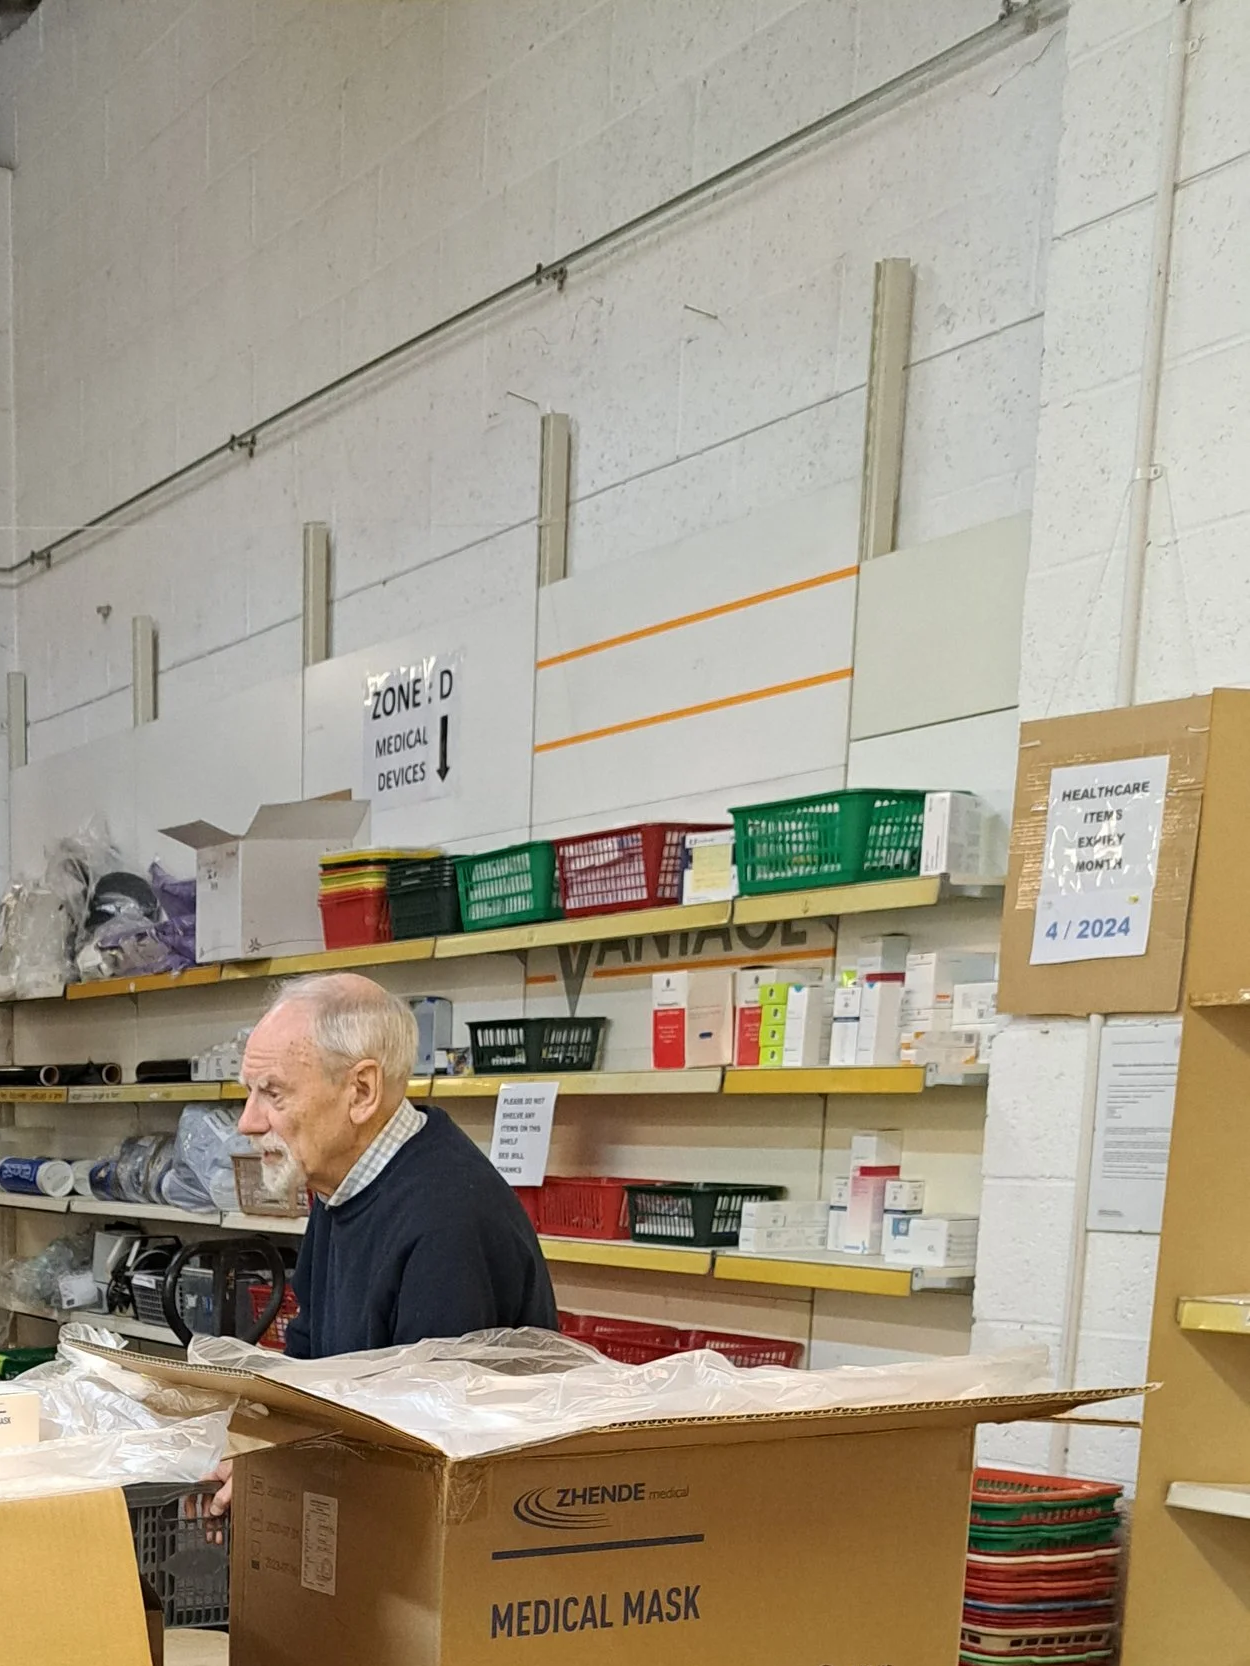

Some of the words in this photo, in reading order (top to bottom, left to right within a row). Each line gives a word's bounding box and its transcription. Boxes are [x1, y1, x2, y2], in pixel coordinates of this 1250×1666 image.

[371, 678, 422, 721] ZONE
[439, 668, 453, 700] D
[375, 725, 428, 759] MEDICAL
[377, 761, 426, 793] DEVICES
[1061, 780, 1150, 802] HEALTHCARE
[1083, 808, 1123, 824] ITEMS
[1075, 857, 1123, 873] MONTH
[1045, 921, 1058, 940] 4
[1076, 915, 1131, 939] 2024
[556, 1482, 646, 1508] ZHENDE
[648, 1485, 690, 1500] medical
[491, 1593, 614, 1640] MEDICAL
[622, 1584, 701, 1627] MASK
